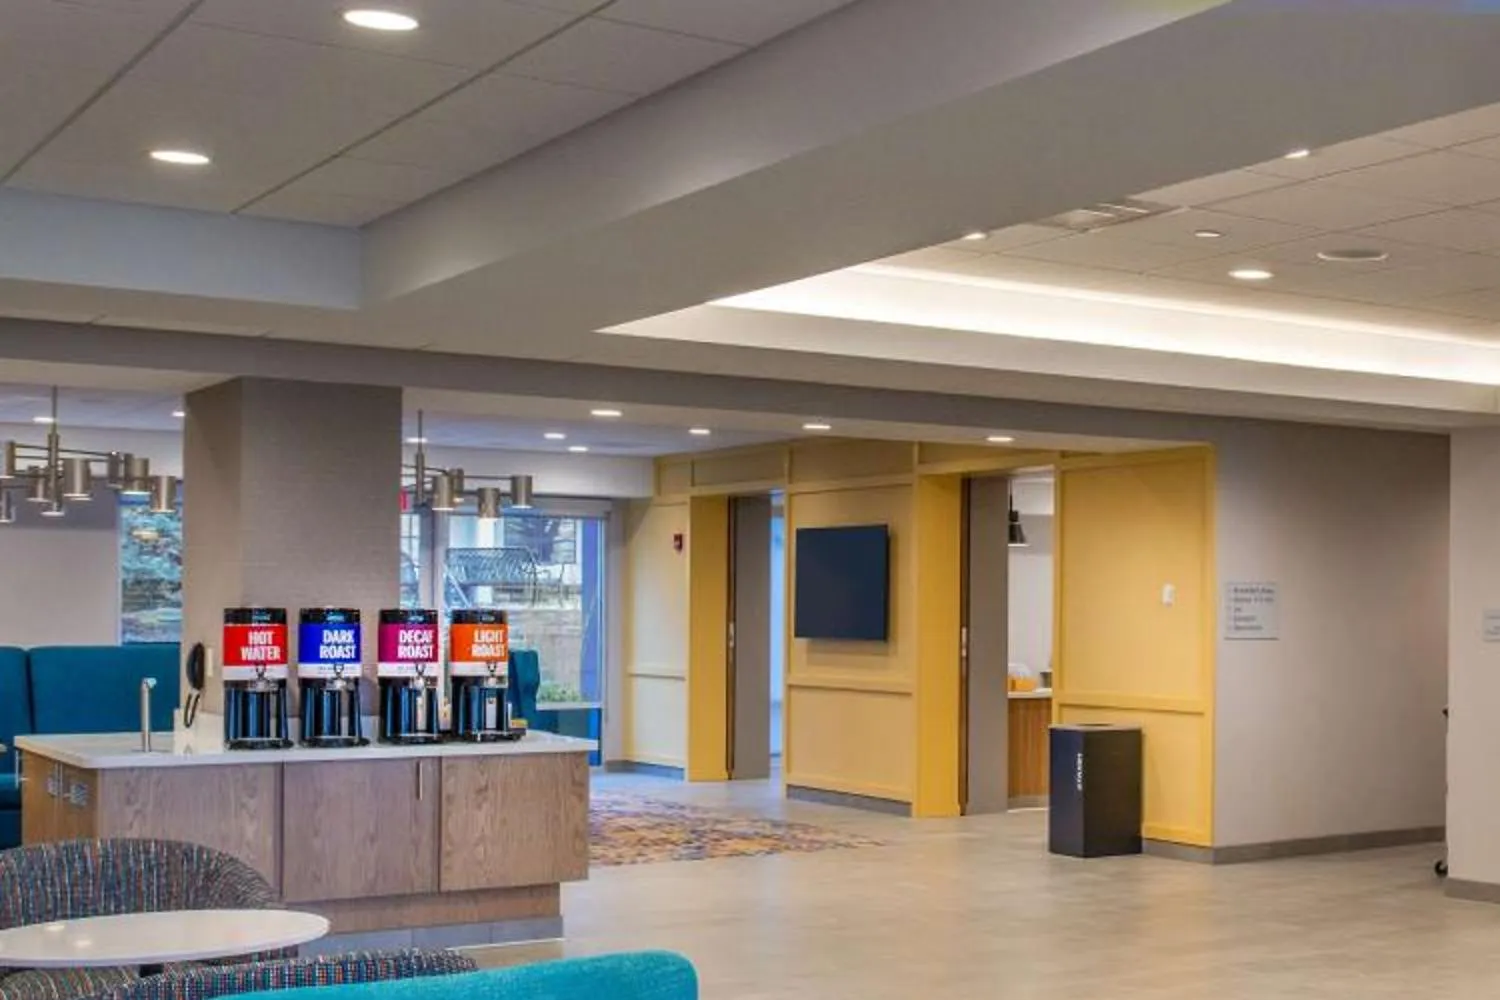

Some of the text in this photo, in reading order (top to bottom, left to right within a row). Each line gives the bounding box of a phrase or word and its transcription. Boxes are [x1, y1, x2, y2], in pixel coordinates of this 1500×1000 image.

[247, 630, 274, 645] HOT
[322, 629, 355, 644] DARK
[398, 629, 435, 643] DECAF
[474, 629, 504, 643] LIGHT
[241, 645, 281, 661] WATER
[319, 644, 356, 659] ROAST
[397, 644, 434, 659] ROAST
[471, 643, 505, 658] ROAST
